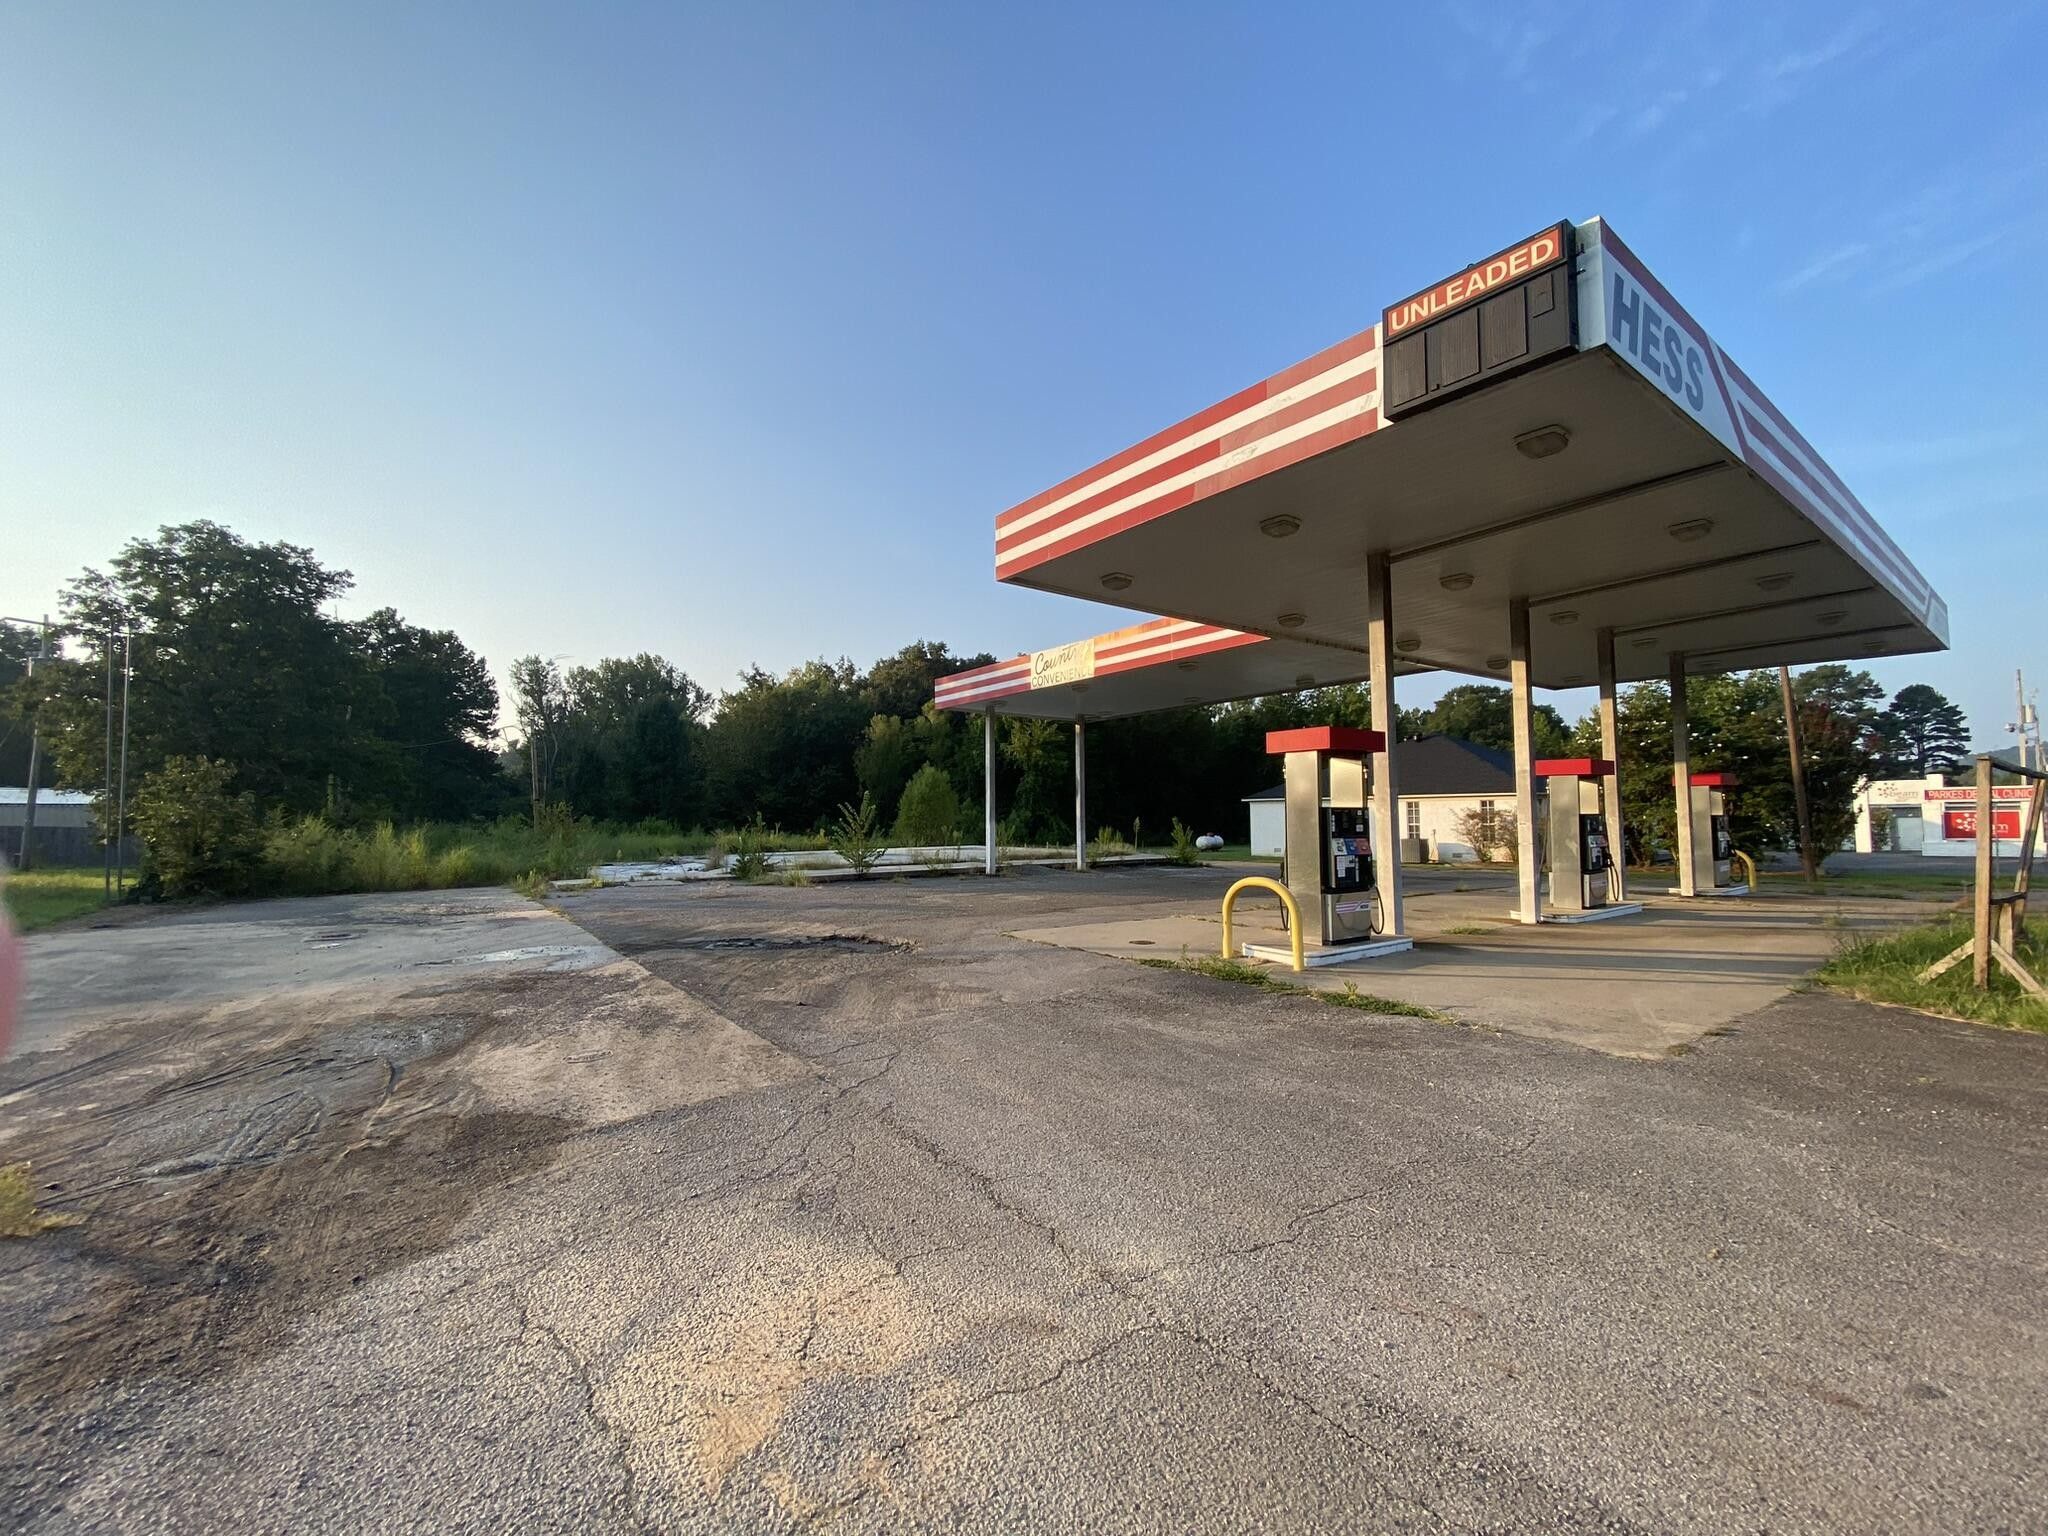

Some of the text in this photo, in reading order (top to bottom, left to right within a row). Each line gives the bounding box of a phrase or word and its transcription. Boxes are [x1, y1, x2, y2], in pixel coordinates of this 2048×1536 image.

[1391, 238, 1554, 331] UNLEADED
[1612, 271, 1704, 412] HESS
[1928, 790, 1964, 799] PARKES
[2003, 788, 2033, 798] CLINIC
